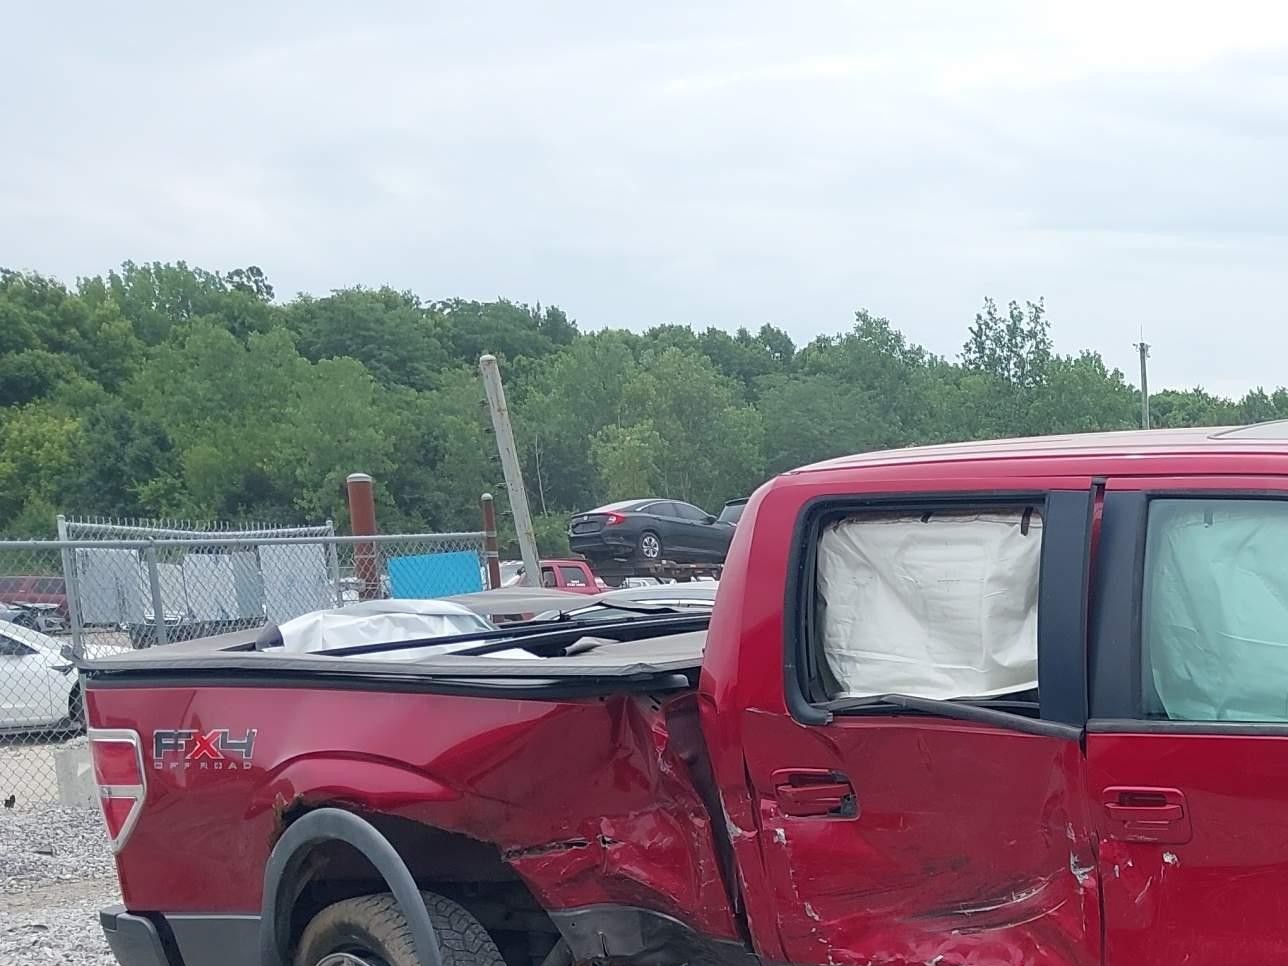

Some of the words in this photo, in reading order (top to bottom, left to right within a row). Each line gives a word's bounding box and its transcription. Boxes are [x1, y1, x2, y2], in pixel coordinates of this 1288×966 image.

[153, 729, 257, 759] FX4
[154, 761, 192, 770] OFF
[199, 761, 252, 770] ROAD
